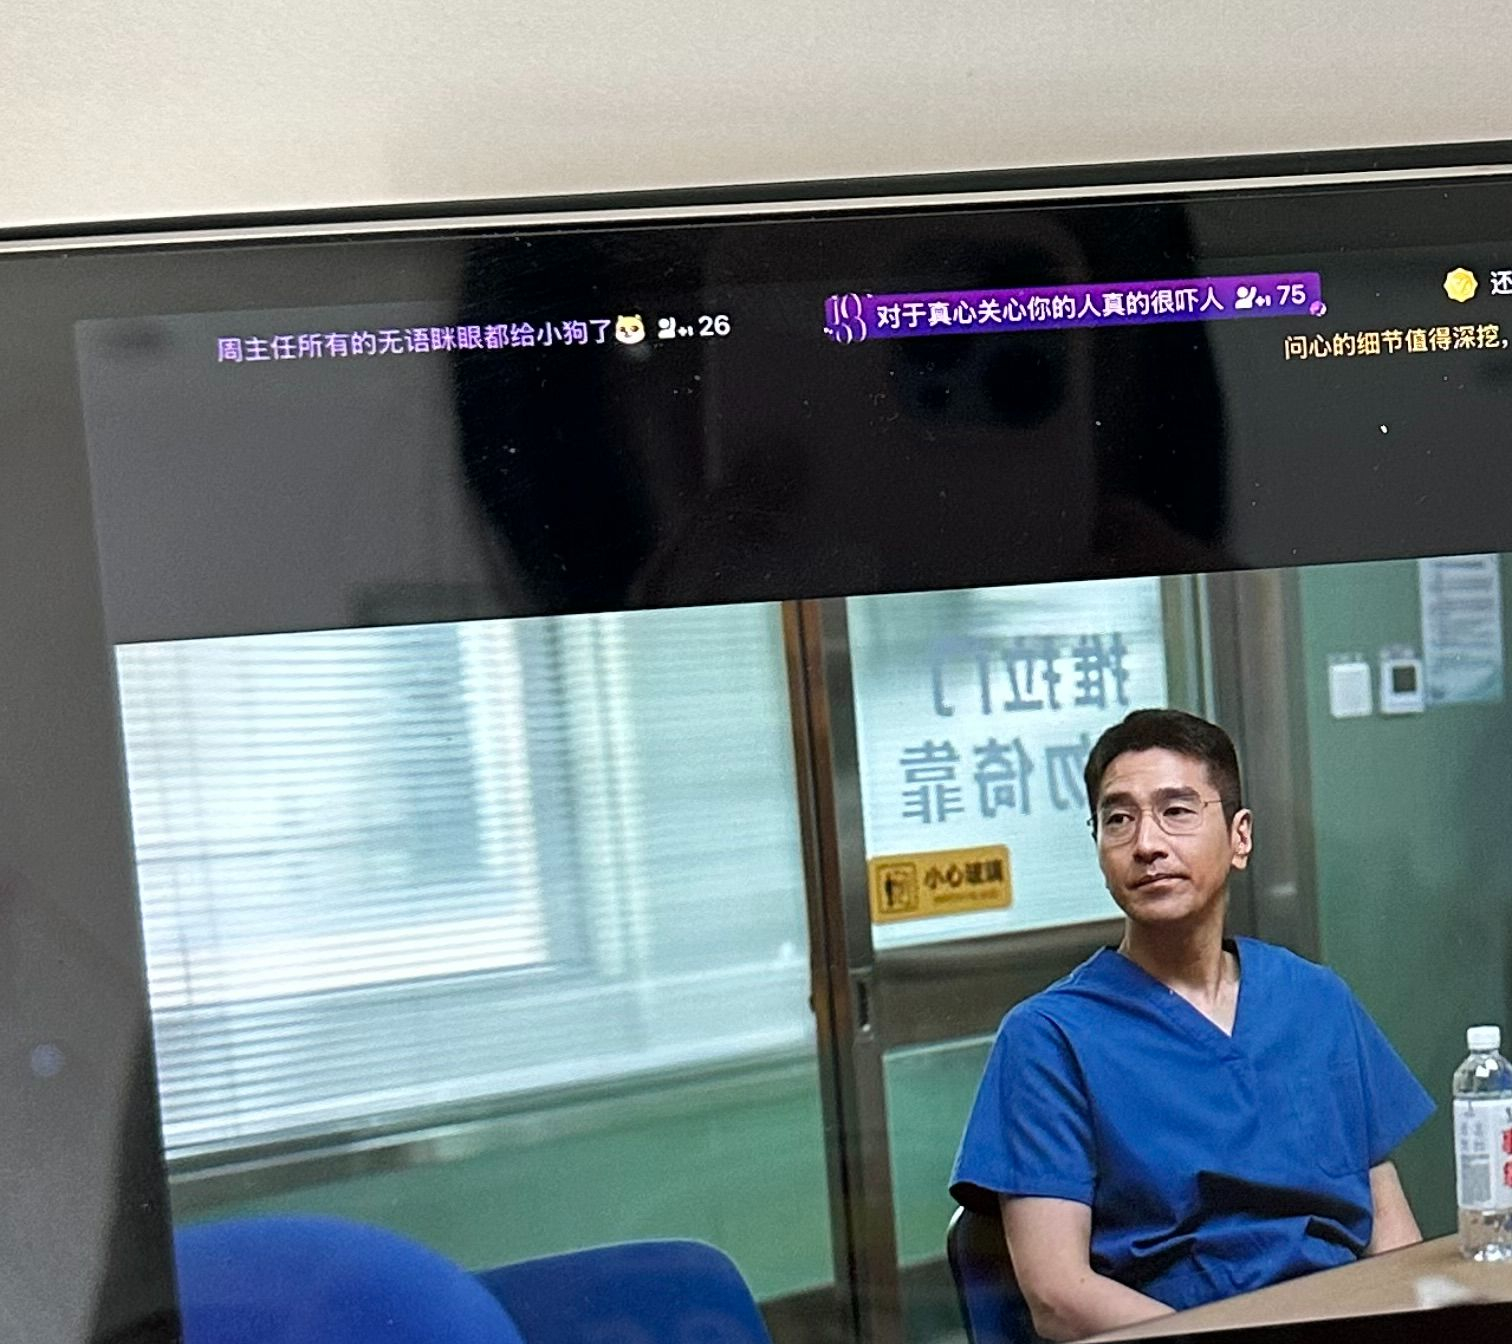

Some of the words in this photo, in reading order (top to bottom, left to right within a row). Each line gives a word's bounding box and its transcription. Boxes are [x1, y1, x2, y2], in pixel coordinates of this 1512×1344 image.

[877, 286, 1225, 329] 对于真心关心你的人真的很吓人
[1276, 284, 1306, 306] 75
[217, 318, 612, 363] 周主任所有的无语眯眼都给小狗了
[698, 314, 731, 337] 26
